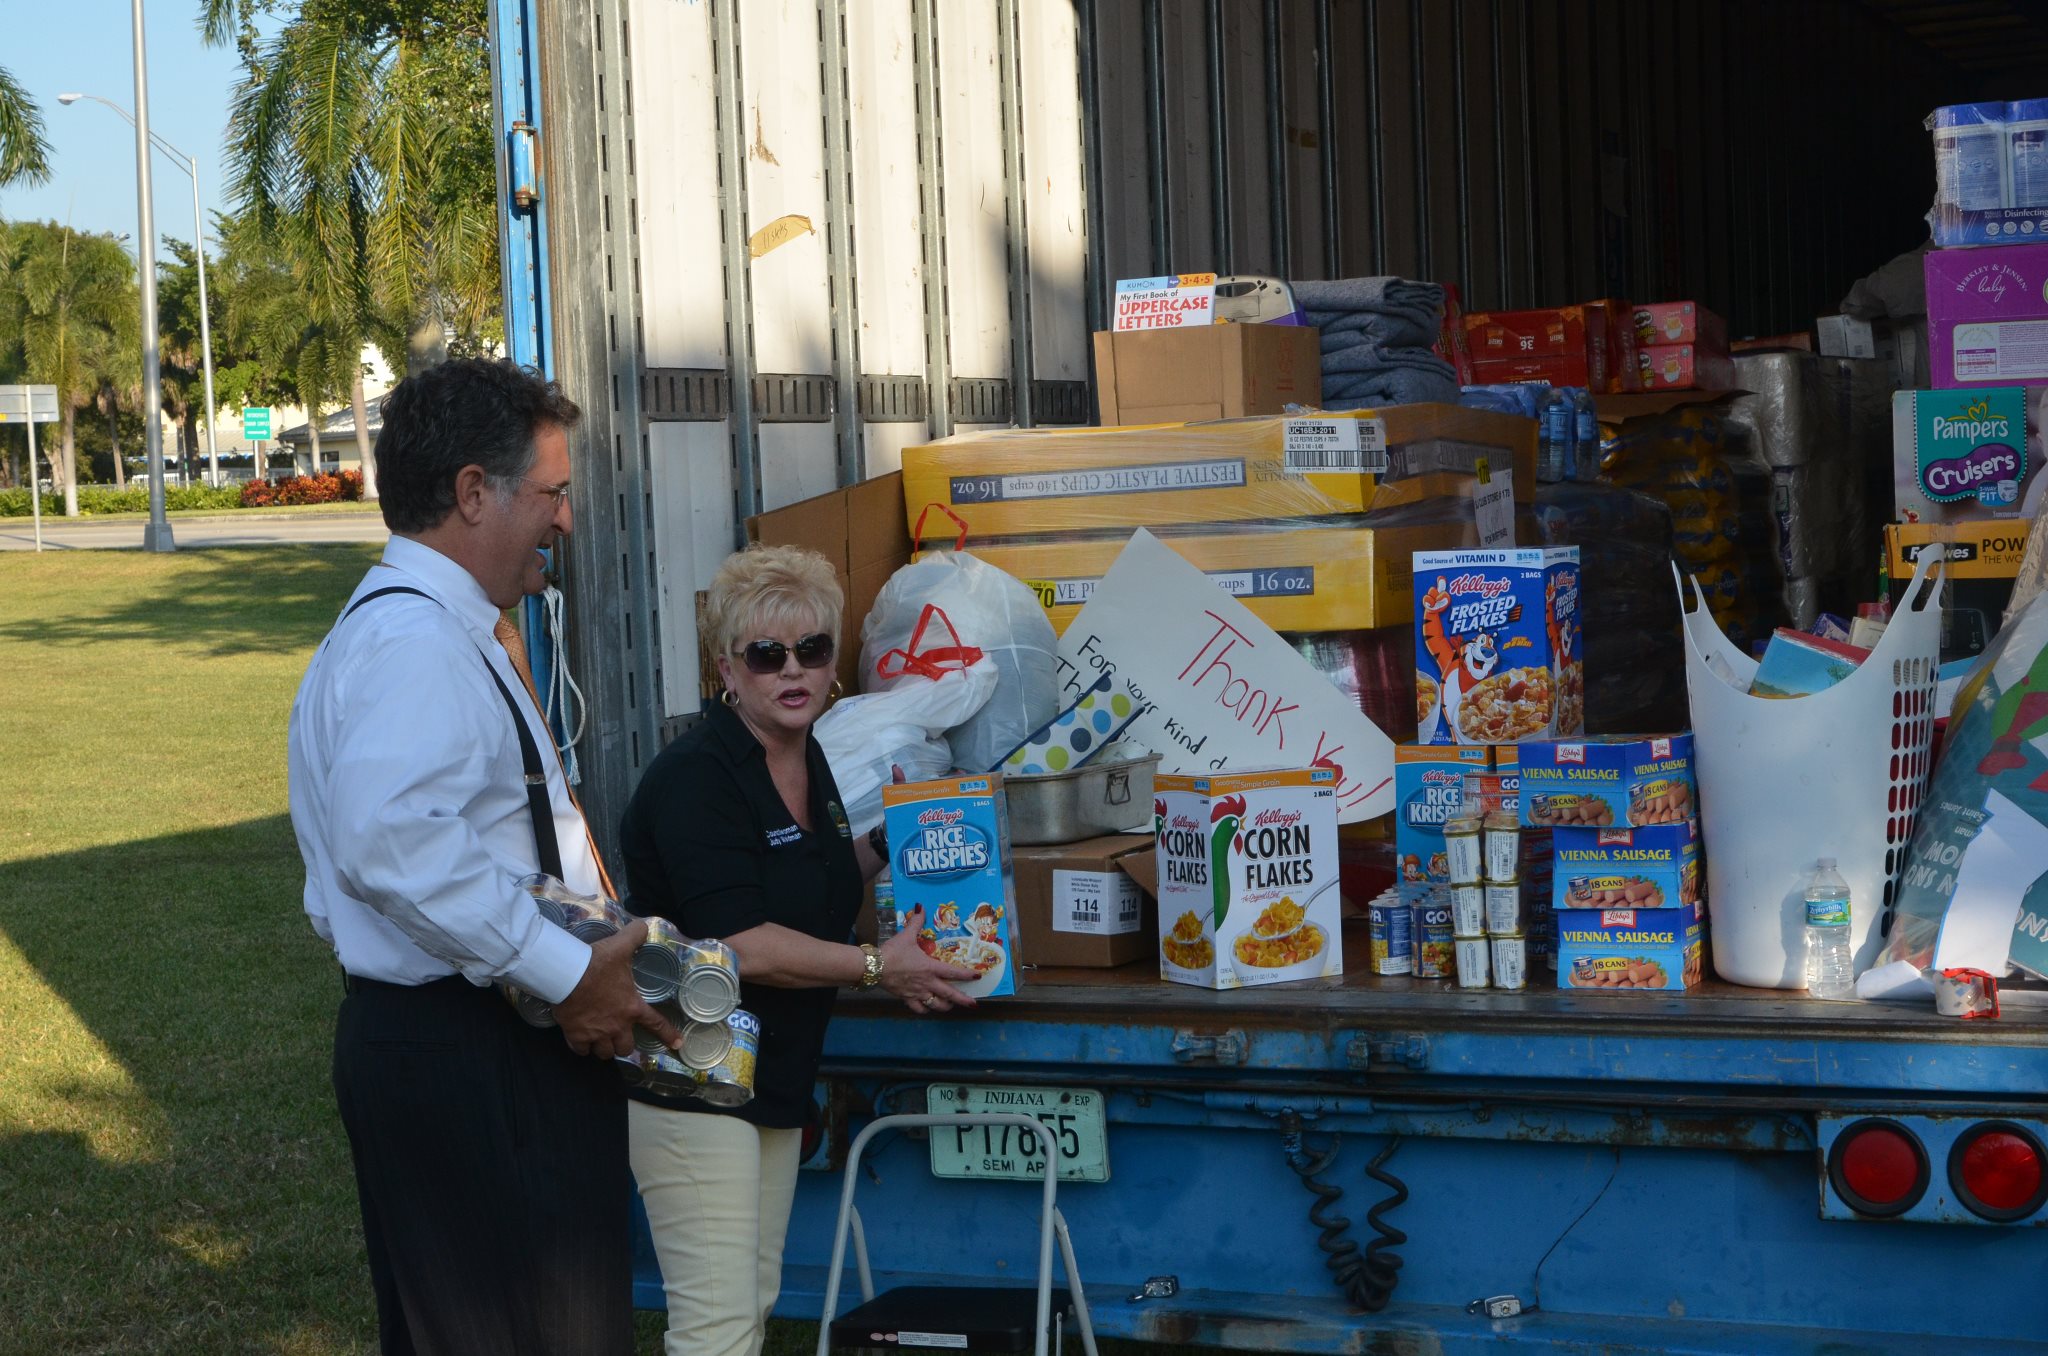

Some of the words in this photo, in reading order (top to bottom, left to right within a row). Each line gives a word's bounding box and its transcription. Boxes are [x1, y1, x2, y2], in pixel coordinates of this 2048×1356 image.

[2004, 208, 2048, 219] Disinfecting
[1127, 280, 1155, 289] KUMON
[1956, 265, 1990, 293] BERKLEY
[1991, 263, 2000, 271] &
[2000, 264, 2026, 290] JENSEN
[1120, 294, 1131, 302] My
[1133, 292, 1148, 300] First
[1150, 291, 1168, 299] Book
[1170, 288, 1179, 297] of
[1977, 275, 2007, 303] baby
[1119, 296, 1209, 316] UPPERCASE
[1118, 312, 1183, 330] LETTERS
[1520, 340, 1534, 351] 36
[1933, 416, 2009, 446] Pampers
[1105, 470, 1169, 490] PLASTIC
[1175, 465, 1238, 484] FESTIVE
[1928, 454, 2016, 490] Cruisers
[952, 482, 974, 494] oz.
[980, 481, 997, 499] 16
[1009, 478, 1034, 490] cups
[1037, 478, 1058, 493] 140
[1061, 475, 1100, 492] CUPS
[1979, 491, 1998, 502] FIT
[1455, 555, 1497, 564] VITAMIN
[1499, 554, 1506, 563] D
[1983, 555, 2002, 565] THE
[1258, 572, 1279, 591] 16
[1284, 573, 1311, 591] oz.
[1526, 571, 1542, 579] BAGS
[1218, 577, 1245, 597] cups
[1449, 573, 1511, 597] Kellogg's
[1556, 587, 1578, 611] FROSTED
[1450, 595, 1517, 621] FROSTED
[1556, 603, 1576, 621] FLAKES
[1452, 611, 1508, 634] FLAKES
[1077, 635, 1117, 675] For
[1177, 609, 1300, 750] Thank
[1559, 746, 1582, 759] Libby's
[1654, 742, 1668, 754] Libby's
[1522, 768, 1564, 780] VIENNA
[1567, 769, 1620, 781] SAUSAGE
[1634, 764, 1659, 776] VIENNA
[1660, 758, 1687, 770] SAUSAGE
[1241, 781, 1261, 789] Simple
[1262, 778, 1281, 787] Grain
[1421, 769, 1461, 785] Kellogg's
[1501, 779, 1519, 790] GO
[1318, 790, 1333, 798] BAGS
[1427, 787, 1460, 806] RICE
[1645, 787, 1652, 797] 18
[1652, 783, 1667, 793] CANS
[1502, 799, 1519, 810] GO
[1550, 799, 1558, 808] 18
[1559, 797, 1578, 806] CANS
[1940, 802, 1962, 813] James
[918, 808, 964, 825] Kellogg's
[1255, 808, 1302, 827] Kellogg's
[1410, 803, 1463, 823] KRISPI
[1962, 807, 1986, 823] Saint
[1172, 814, 1200, 831] Kellogg's
[922, 826, 965, 850] RICE
[1954, 826, 1975, 839] man
[1166, 829, 1206, 859] CORN
[1243, 824, 1311, 860] CORN
[907, 843, 988, 873] KRISPIES
[1559, 850, 1608, 861] VIENNA
[1613, 849, 1672, 861] SAUSAGE
[1167, 859, 1208, 886] FLAKES
[1246, 859, 1314, 891] FLAKES
[1590, 879, 1601, 889] 18
[1602, 878, 1623, 887] CANS
[1074, 897, 1098, 912] 114
[1121, 897, 1137, 911] 114
[1810, 904, 1842, 914] Zephyrhills
[1425, 911, 1453, 924] GOY
[1607, 911, 1630, 921] Libby's
[1563, 931, 1611, 943] VIENNA
[1616, 931, 1675, 943] SAUSAGE
[1595, 962, 1604, 970] 18
[1606, 960, 1626, 968] CANS
[940, 1090, 953, 1101] NO
[985, 1091, 1044, 1106] INDIANA
[1075, 1096, 1090, 1106] EXP
[982, 1159, 1015, 1172] SEMI
